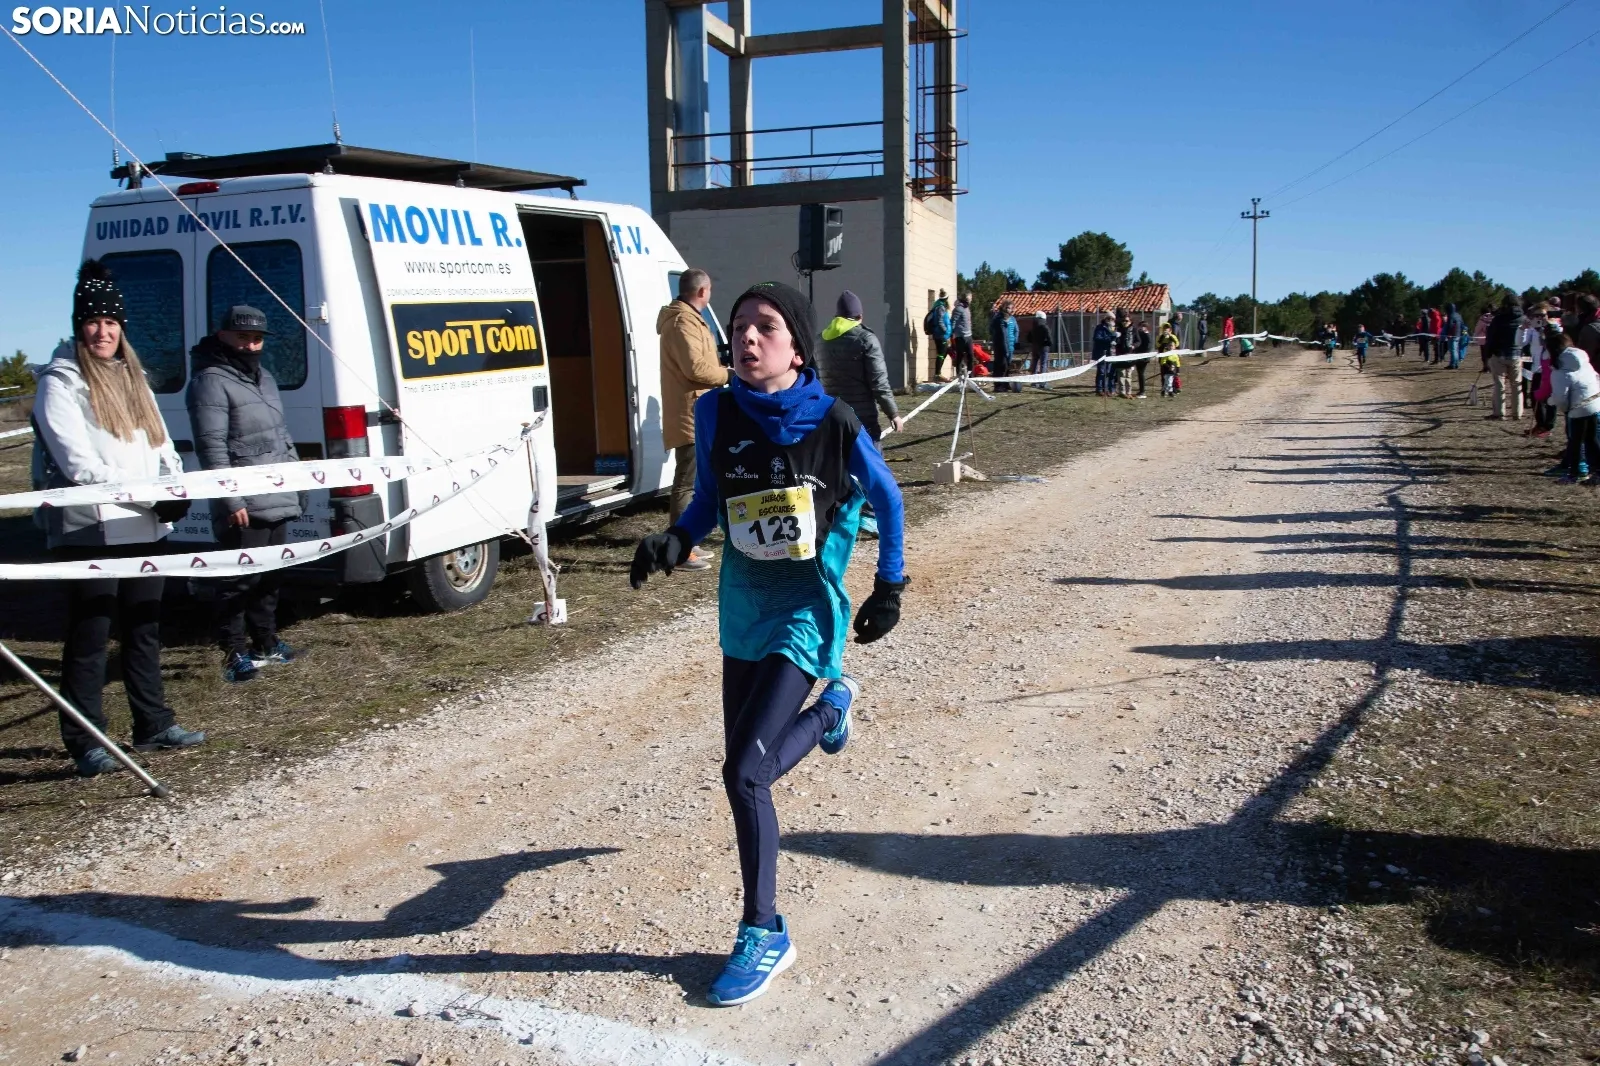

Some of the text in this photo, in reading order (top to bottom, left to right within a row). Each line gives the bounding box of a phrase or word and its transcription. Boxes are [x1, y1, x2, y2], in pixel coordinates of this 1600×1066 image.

[96, 203, 306, 241] UNIDAD MOVIL R.T.V.
[368, 203, 650, 255] MOVIL R. T.V.
[404, 260, 512, 278] www.sportcom.es
[292, 528, 320, 539] SORIA
[748, 515, 802, 546] 123
